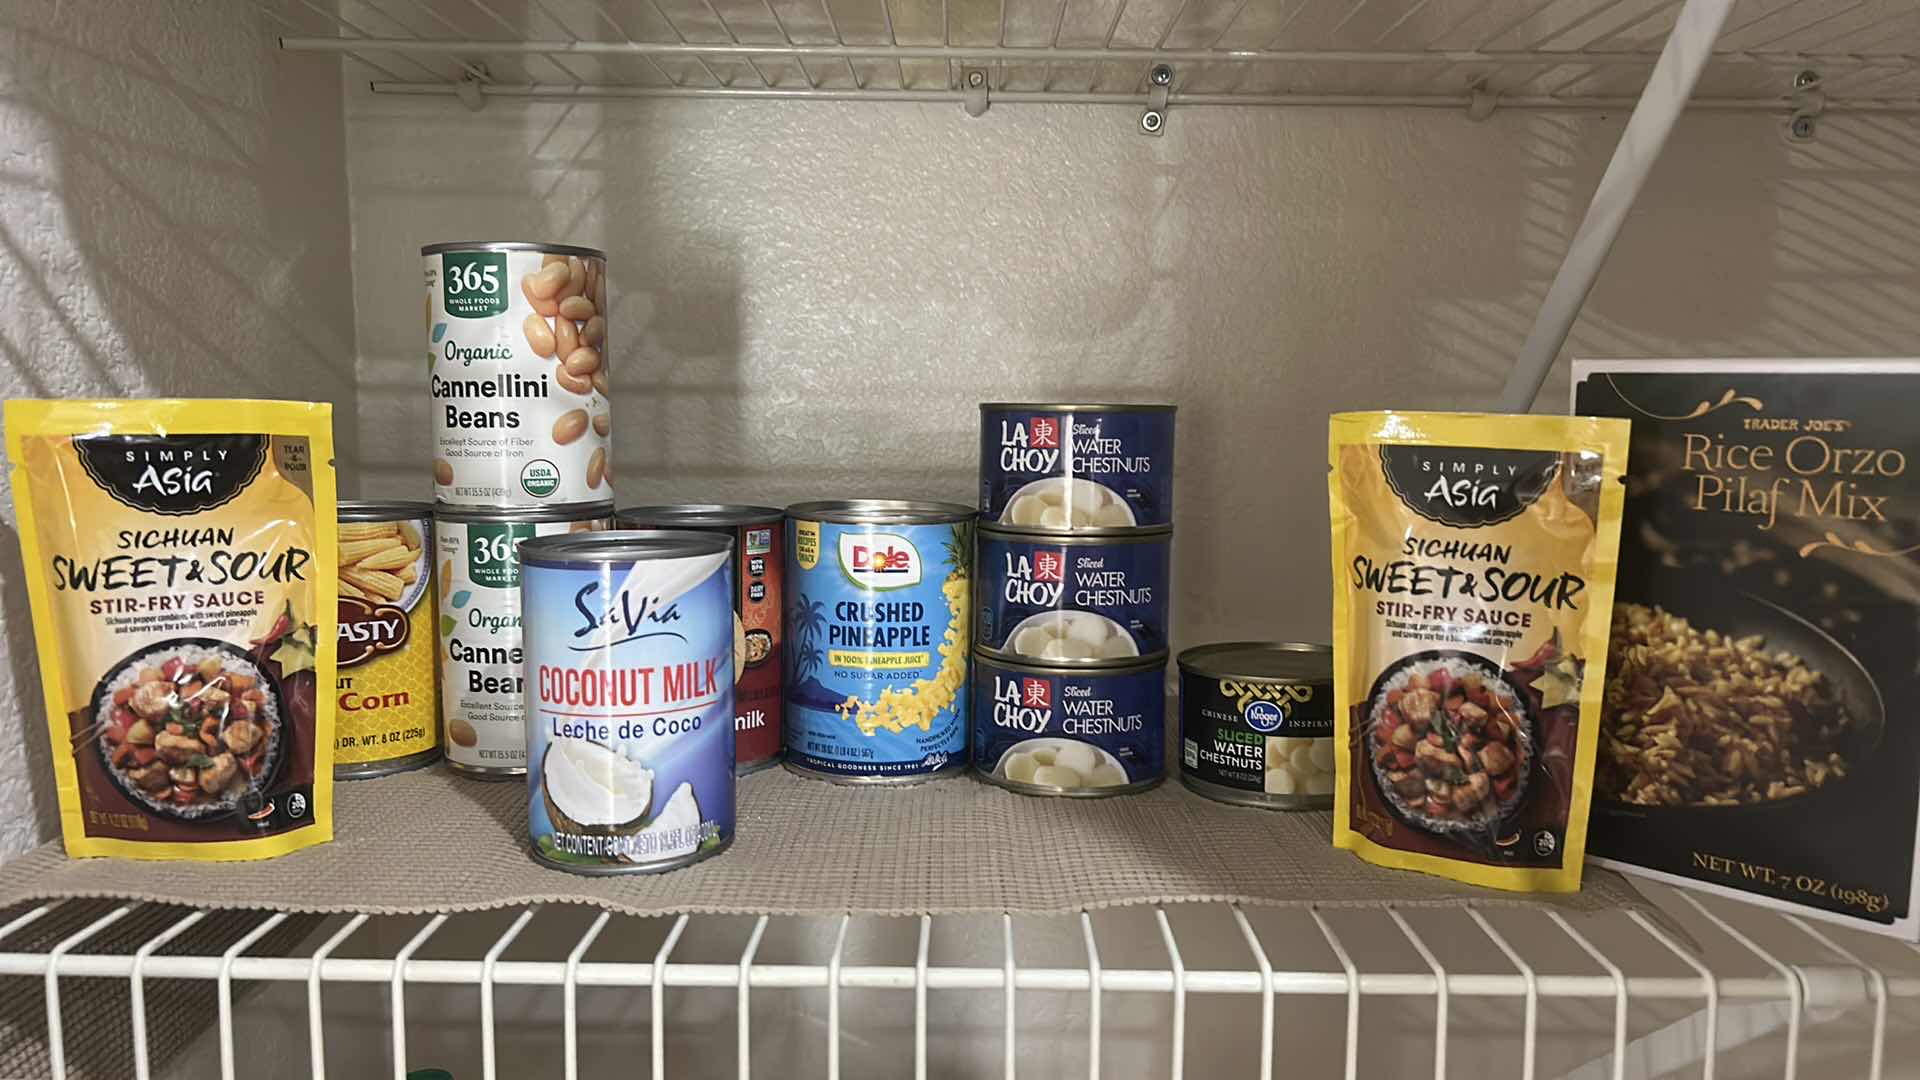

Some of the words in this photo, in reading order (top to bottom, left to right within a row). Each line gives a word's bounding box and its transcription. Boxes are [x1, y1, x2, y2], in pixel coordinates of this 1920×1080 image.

[448, 262, 499, 294] 365
[444, 340, 513, 367] Organic
[431, 374, 549, 399] Cannellini
[445, 405, 520, 429] Beans
[1743, 418, 1799, 430] TRADER
[467, 438, 497, 446] Source
[511, 438, 535, 447] Fiber
[1001, 420, 1029, 447] LA
[1032, 420, 1057, 446] 東
[126, 450, 229, 462] SIMPLY
[445, 448, 462, 456] Good
[464, 449, 492, 457] Source
[1072, 438, 1121, 455] WATER
[1681, 433, 1774, 472] Rice
[1786, 435, 1906, 477] Orzo
[1000, 447, 1059, 473] CHOY
[1072, 457, 1150, 473] CHESTNUTS
[1422, 460, 1519, 476] SIMPLY
[132, 465, 213, 496] Asia
[527, 479, 555, 487] ORGANIC
[530, 469, 552, 477] USDA
[1424, 474, 1499, 510] Asia
[1692, 474, 1790, 531] Pilaf
[1794, 479, 1887, 522] Mix
[117, 527, 235, 549] SICHUAN
[853, 546, 910, 569] Dole
[1402, 537, 1512, 564] SICHUAN
[1005, 552, 1032, 580] LA
[1036, 554, 1062, 580] 東
[1077, 558, 1104, 569] Sliced
[1075, 572, 1126, 588] WATER
[90, 595, 186, 615] STIR-FRY
[194, 590, 264, 608] SAUCE
[1005, 579, 1064, 607] CHOY
[1075, 587, 1152, 606] CHESTNUTS
[469, 608, 522, 634] Organ
[1376, 601, 1458, 622] STIR-FRY
[1464, 608, 1532, 628] SAUCE
[336, 619, 399, 642] ASTY
[829, 625, 930, 647] PINEAPPLE
[449, 638, 523, 664] Canne
[866, 656, 901, 664] PNEAPPLE
[336, 678, 352, 689] UT
[468, 670, 524, 694] Bea
[539, 664, 655, 707] COCONUT
[663, 658, 717, 703] MILK
[834, 671, 848, 679] NO
[851, 671, 884, 680] SUGAR
[338, 692, 409, 711] Corn
[994, 676, 1021, 705] LA
[1026, 681, 1049, 706] 東
[1064, 686, 1092, 697] Sliced
[468, 711, 487, 720] Good
[489, 713, 519, 721] Source
[494, 702, 524, 711] Source
[993, 702, 1051, 733] CHOY
[1063, 700, 1113, 716] WATER
[1250, 706, 1278, 727] Kroger
[553, 717, 609, 741] Leche
[619, 720, 644, 739] de
[653, 716, 701, 737] Coco
[1063, 715, 1142, 734] CHESTNUTS
[1202, 709, 1238, 723] CHINESE
[1289, 720, 1332, 728] INSPIRA
[342, 737, 358, 747] DR.
[362, 735, 379, 746] WT.
[382, 734, 387, 744] 8
[390, 732, 401, 742] OZ
[403, 727, 425, 742] (225g)
[1217, 728, 1263, 746] SLICED
[1200, 749, 1263, 770] CHESTNUTS
[1214, 740, 1263, 758] WATER
[807, 757, 834, 768] TROPICAL
[838, 762, 876, 771] GOODNESS
[1692, 851, 1736, 874] NET
[1739, 863, 1776, 885] WT.
[1780, 876, 1791, 889] 7
[1796, 876, 1825, 896] OZ
[1830, 883, 1889, 912] (198g)
